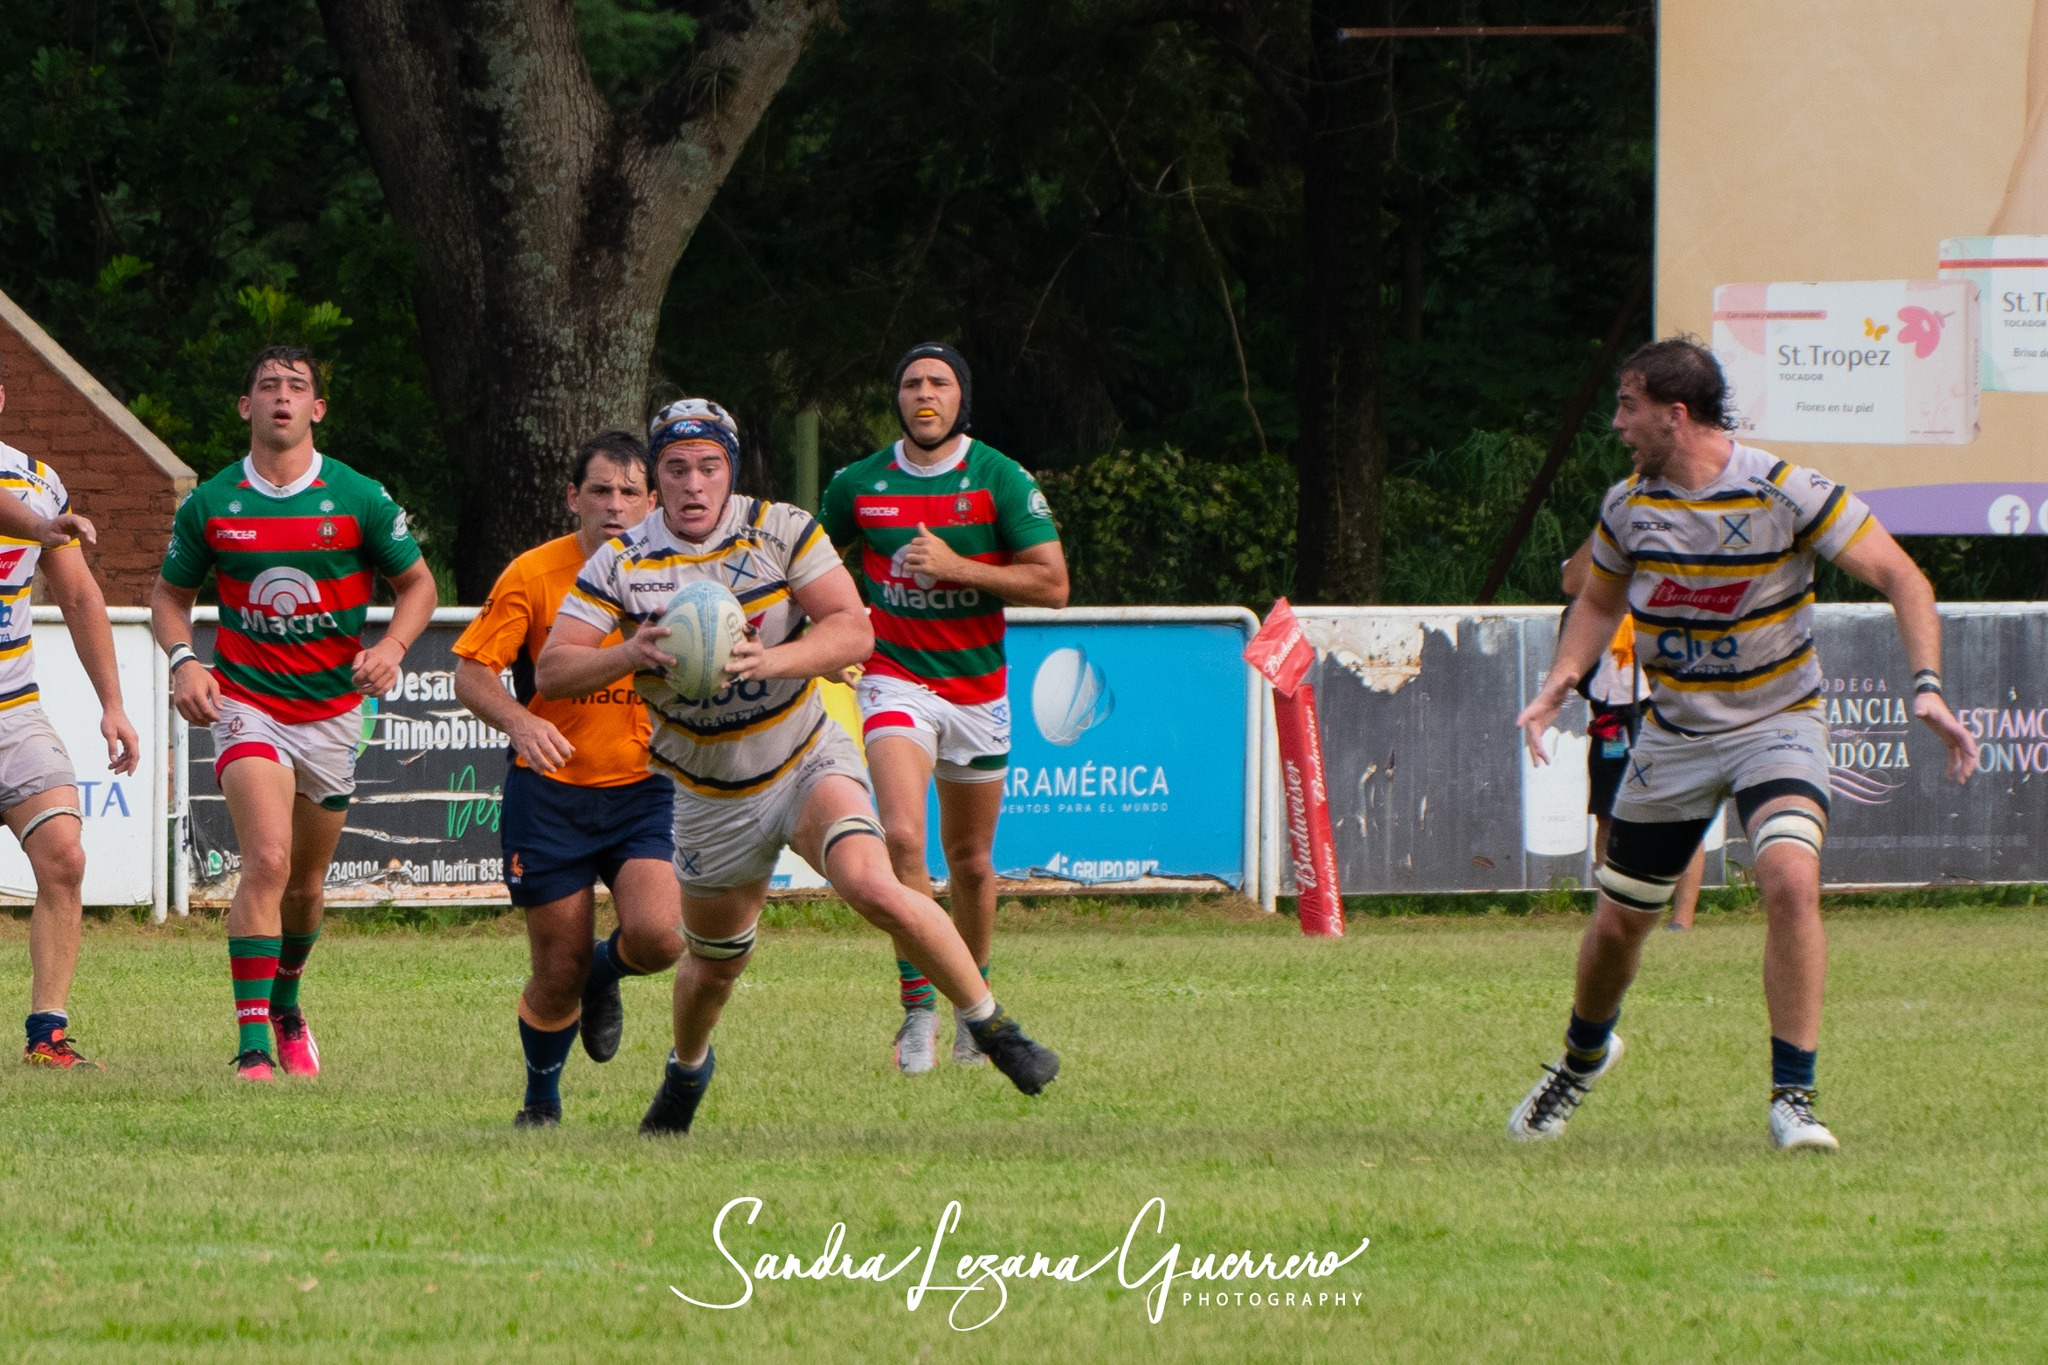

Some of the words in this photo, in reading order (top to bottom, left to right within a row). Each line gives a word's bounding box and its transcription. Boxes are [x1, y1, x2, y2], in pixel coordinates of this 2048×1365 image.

[2003, 291, 2048, 313] St.T
[1779, 373, 1824, 382] TOCADOR
[1796, 402, 1826, 413] Flores
[1828, 404, 1840, 413] en
[1842, 403, 1854, 413] tu
[1855, 401, 1875, 414] piel
[859, 505, 900, 517] PROCER
[215, 529, 257, 541] PROCER
[882, 579, 980, 610] Macro
[240, 605, 338, 637] Macro
[1820, 678, 1888, 692] ODEGA
[1822, 698, 1909, 724] ANCIA
[1304, 705, 1328, 807] Budweiser
[1828, 741, 1911, 768] NDOZA
[1976, 742, 2048, 773] ONVO
[1000, 803, 1051, 814] MENTOS
[1057, 802, 1093, 813] PARA
[1100, 802, 1115, 813] EL
[1122, 802, 1169, 813] MUNDO
[1286, 759, 1319, 896] Budweiser
[431, 858, 477, 883] Martín
[1072, 860, 1124, 879] GRUPO
[1322, 842, 1345, 938] Budweiser
